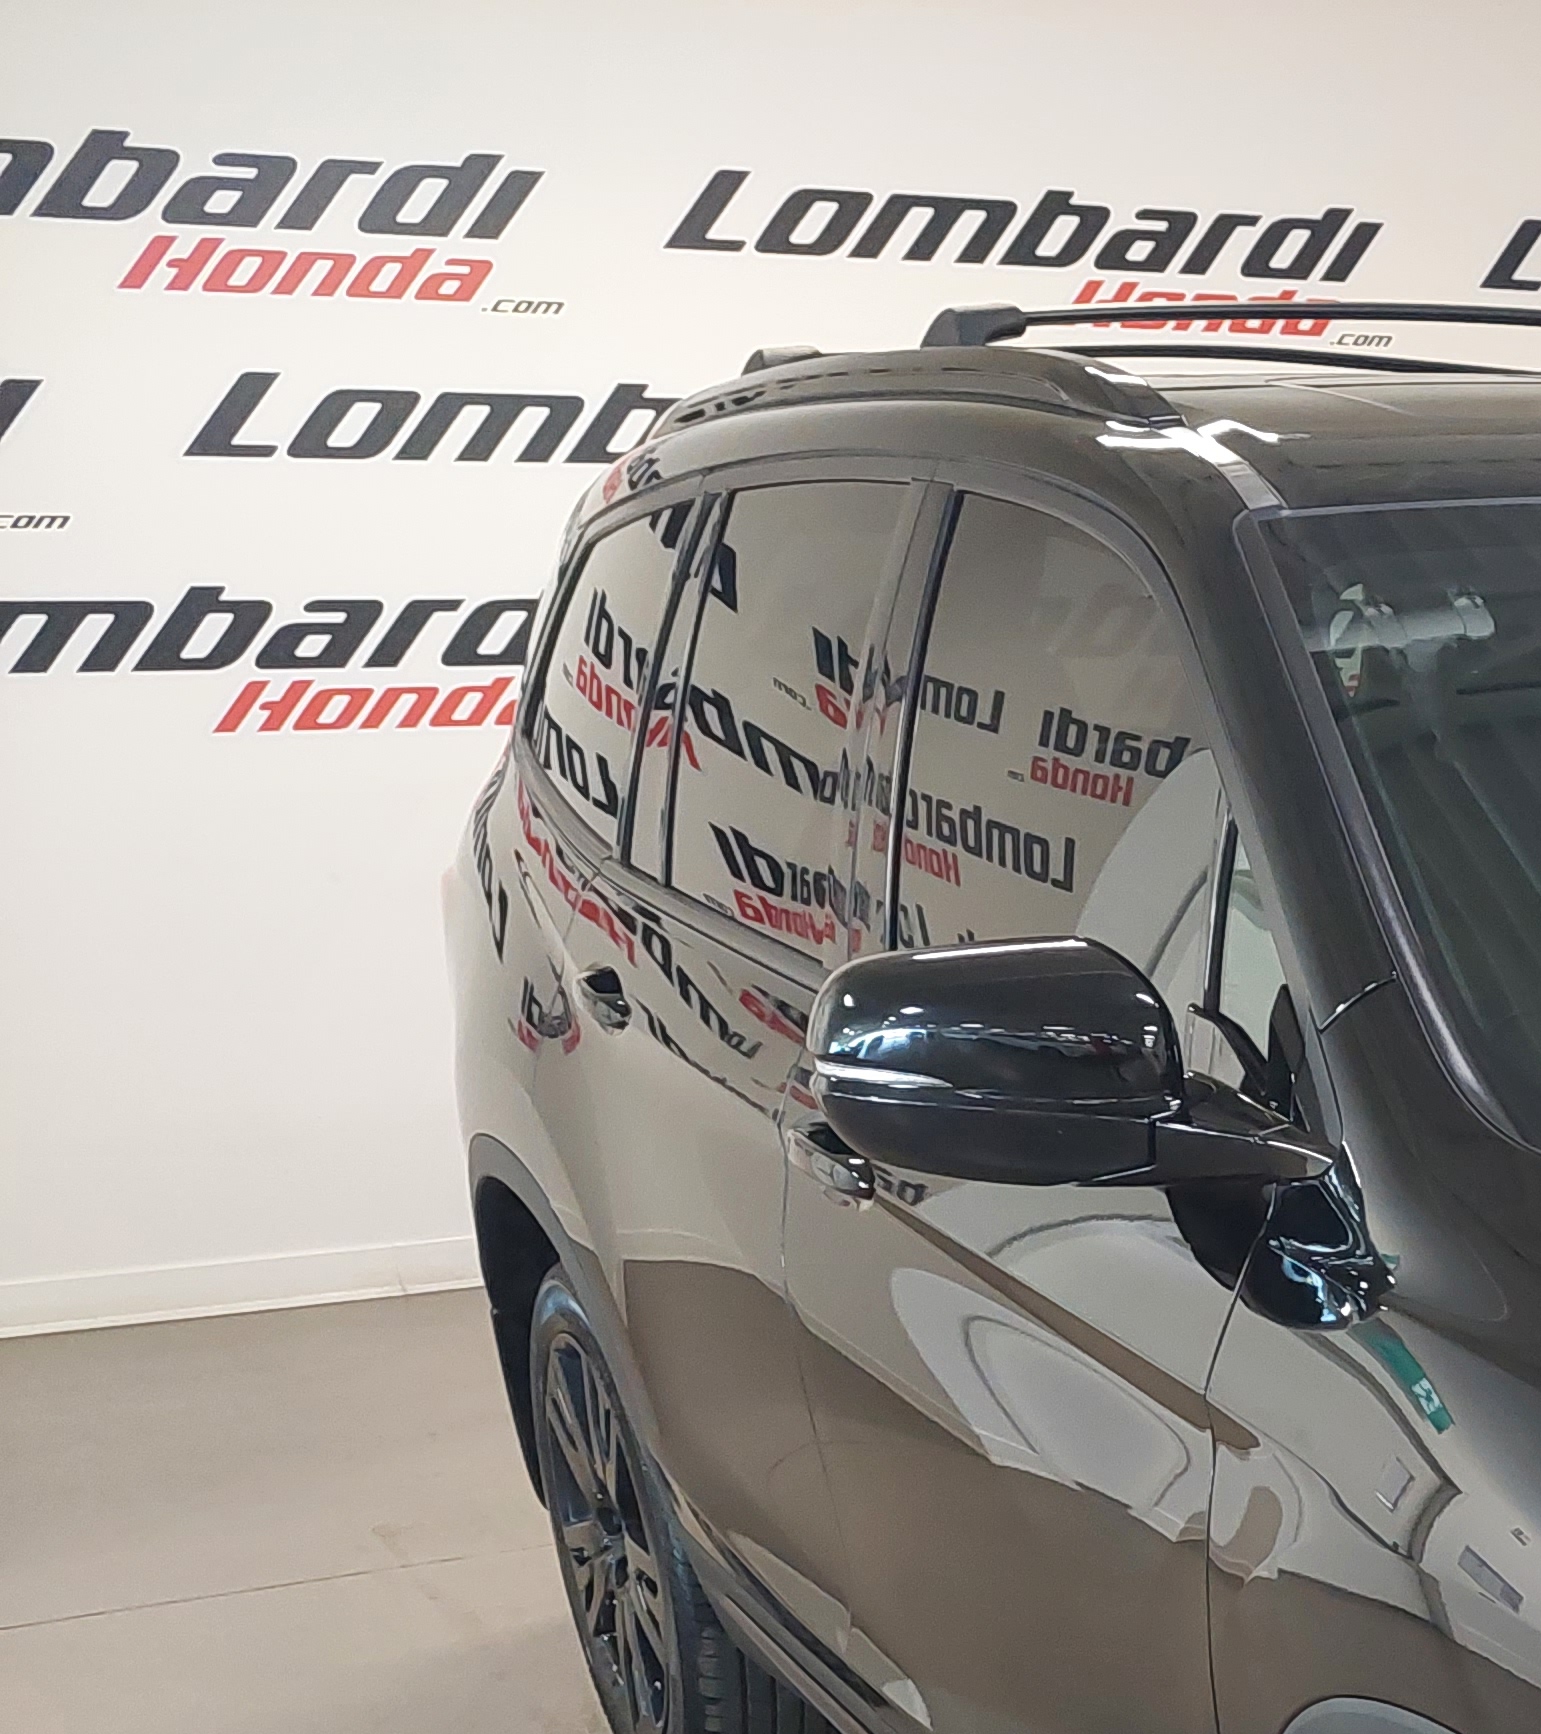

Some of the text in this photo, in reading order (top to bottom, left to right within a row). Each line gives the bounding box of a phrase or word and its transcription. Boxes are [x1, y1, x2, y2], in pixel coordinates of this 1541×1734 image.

[664, 169, 1384, 282] Lombardi
[119, 236, 565, 315] Honda .com
[1335, 333, 1393, 348] .com
